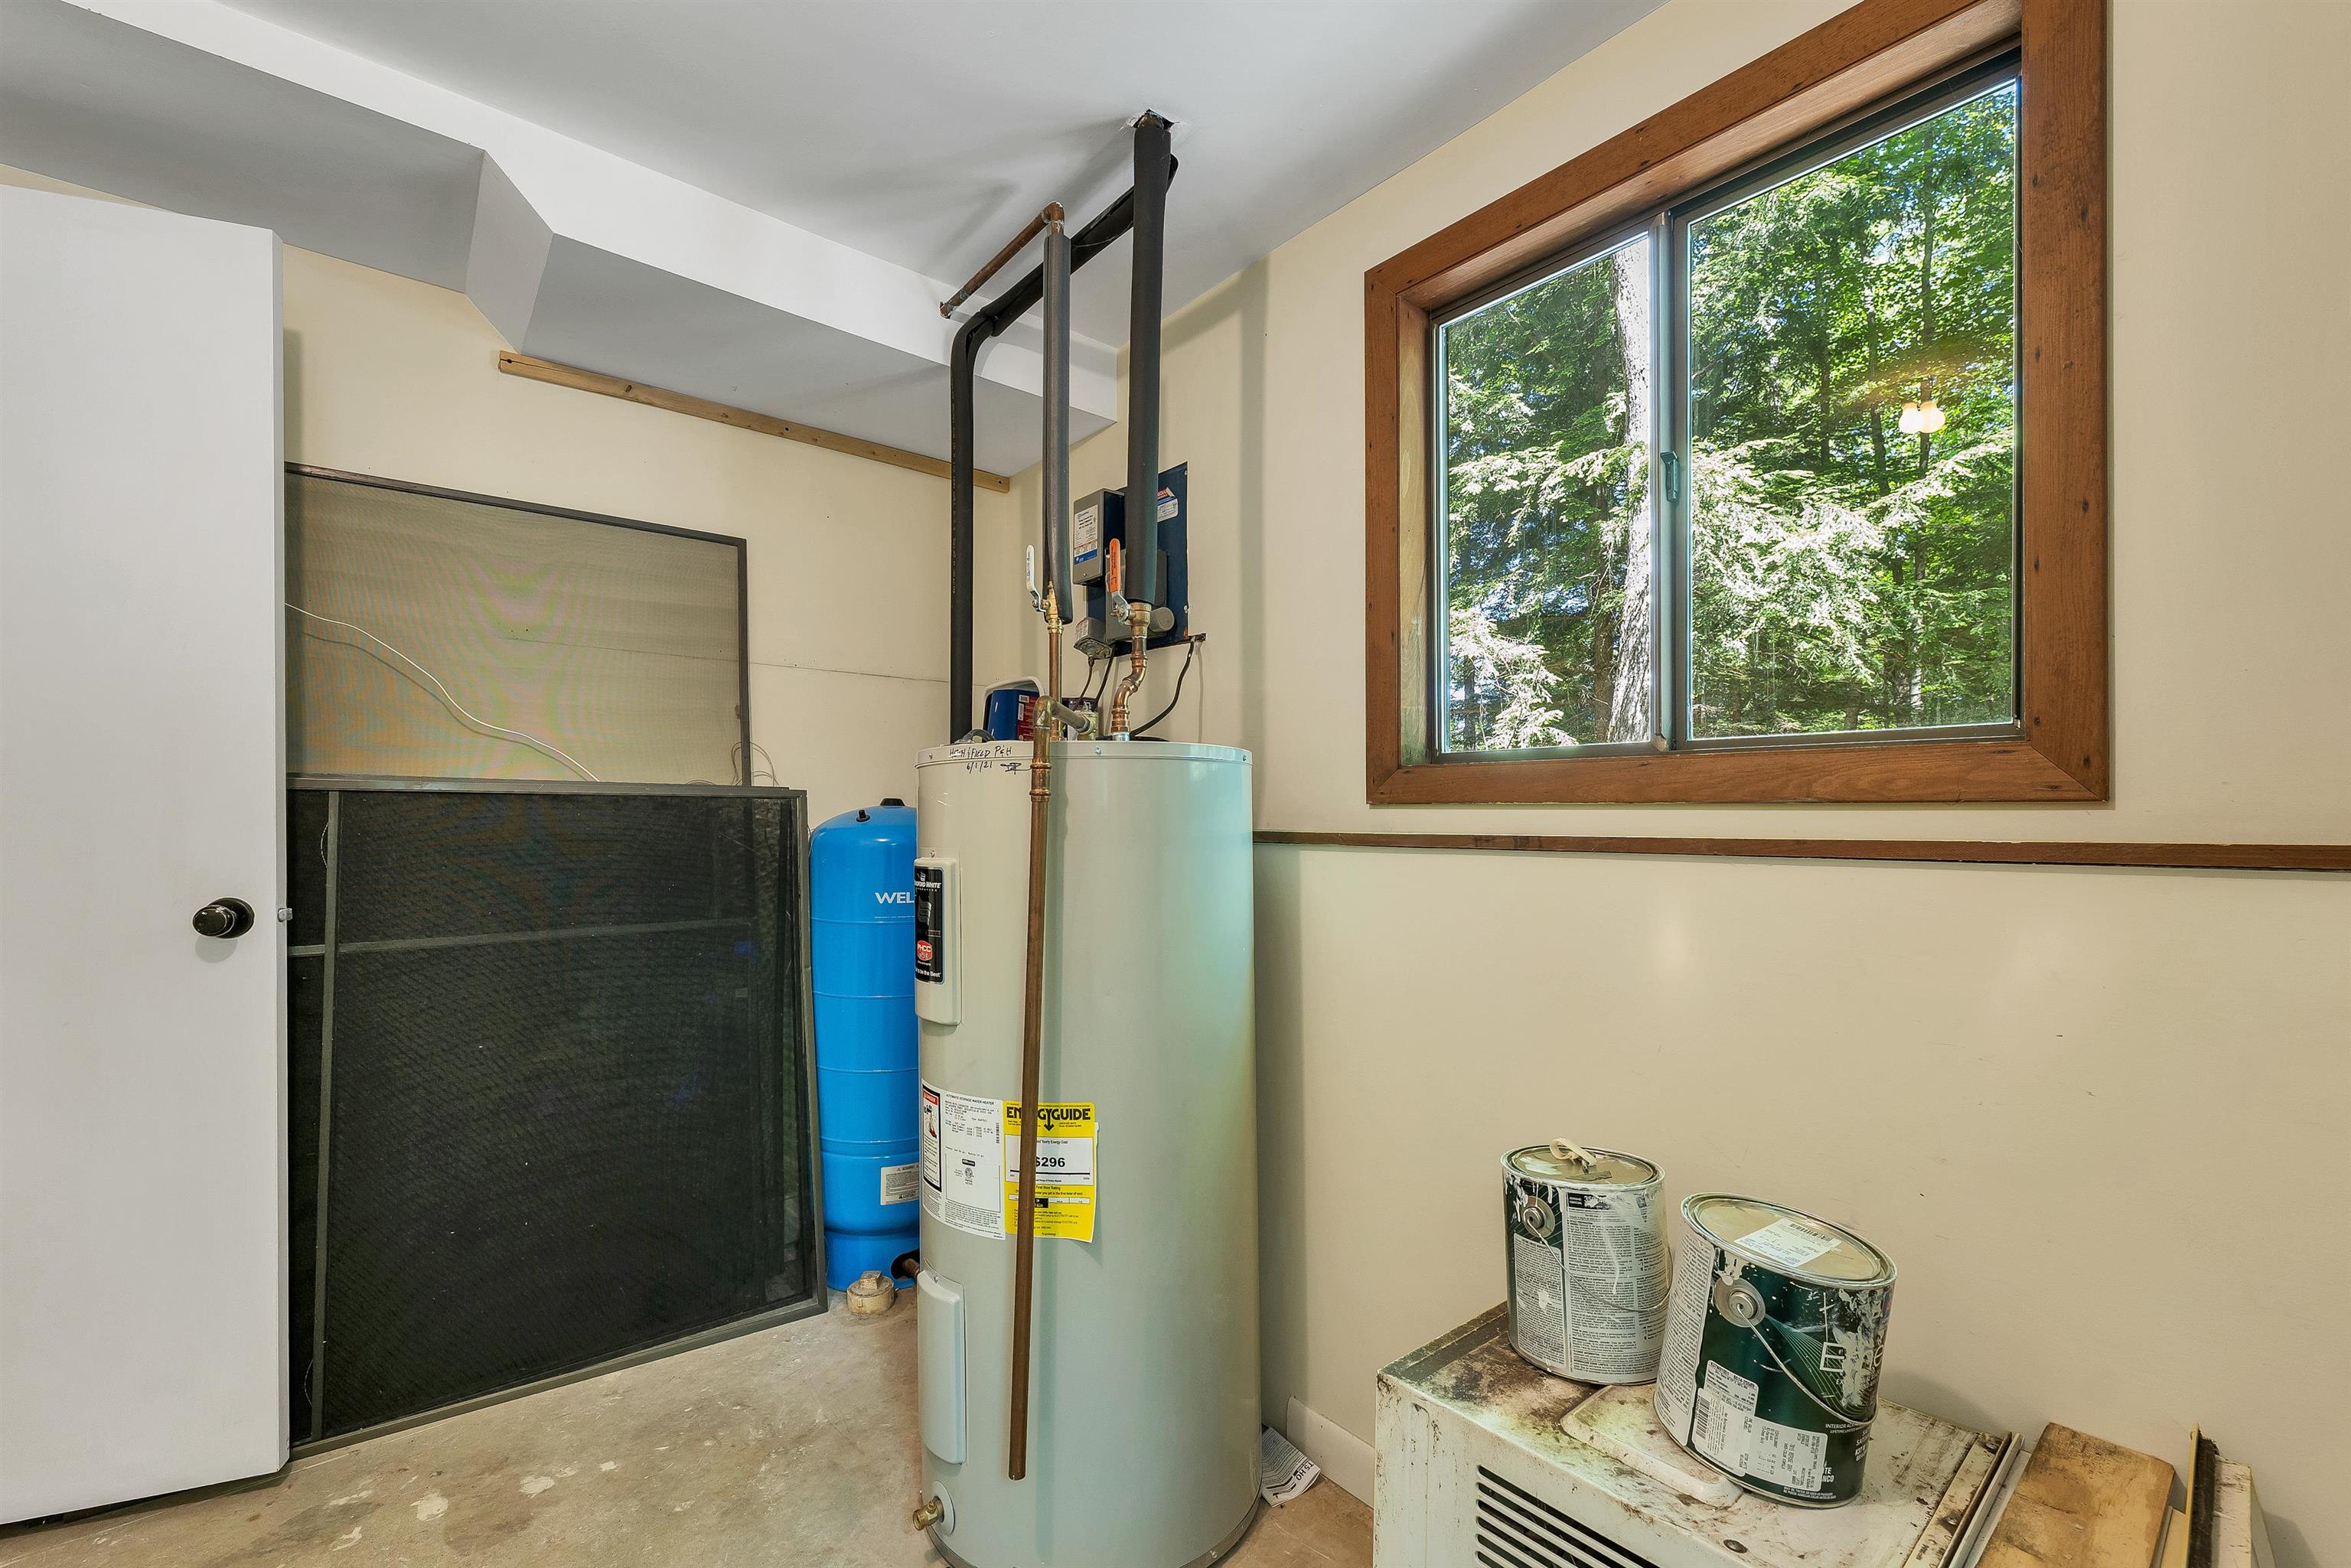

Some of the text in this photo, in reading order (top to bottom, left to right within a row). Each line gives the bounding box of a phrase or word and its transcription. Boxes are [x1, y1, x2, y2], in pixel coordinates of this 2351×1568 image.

[967, 761, 993, 774] 6/1/21
[875, 892, 915, 904] WEL
[1006, 1107, 1091, 1120] ENGYGUIDE
